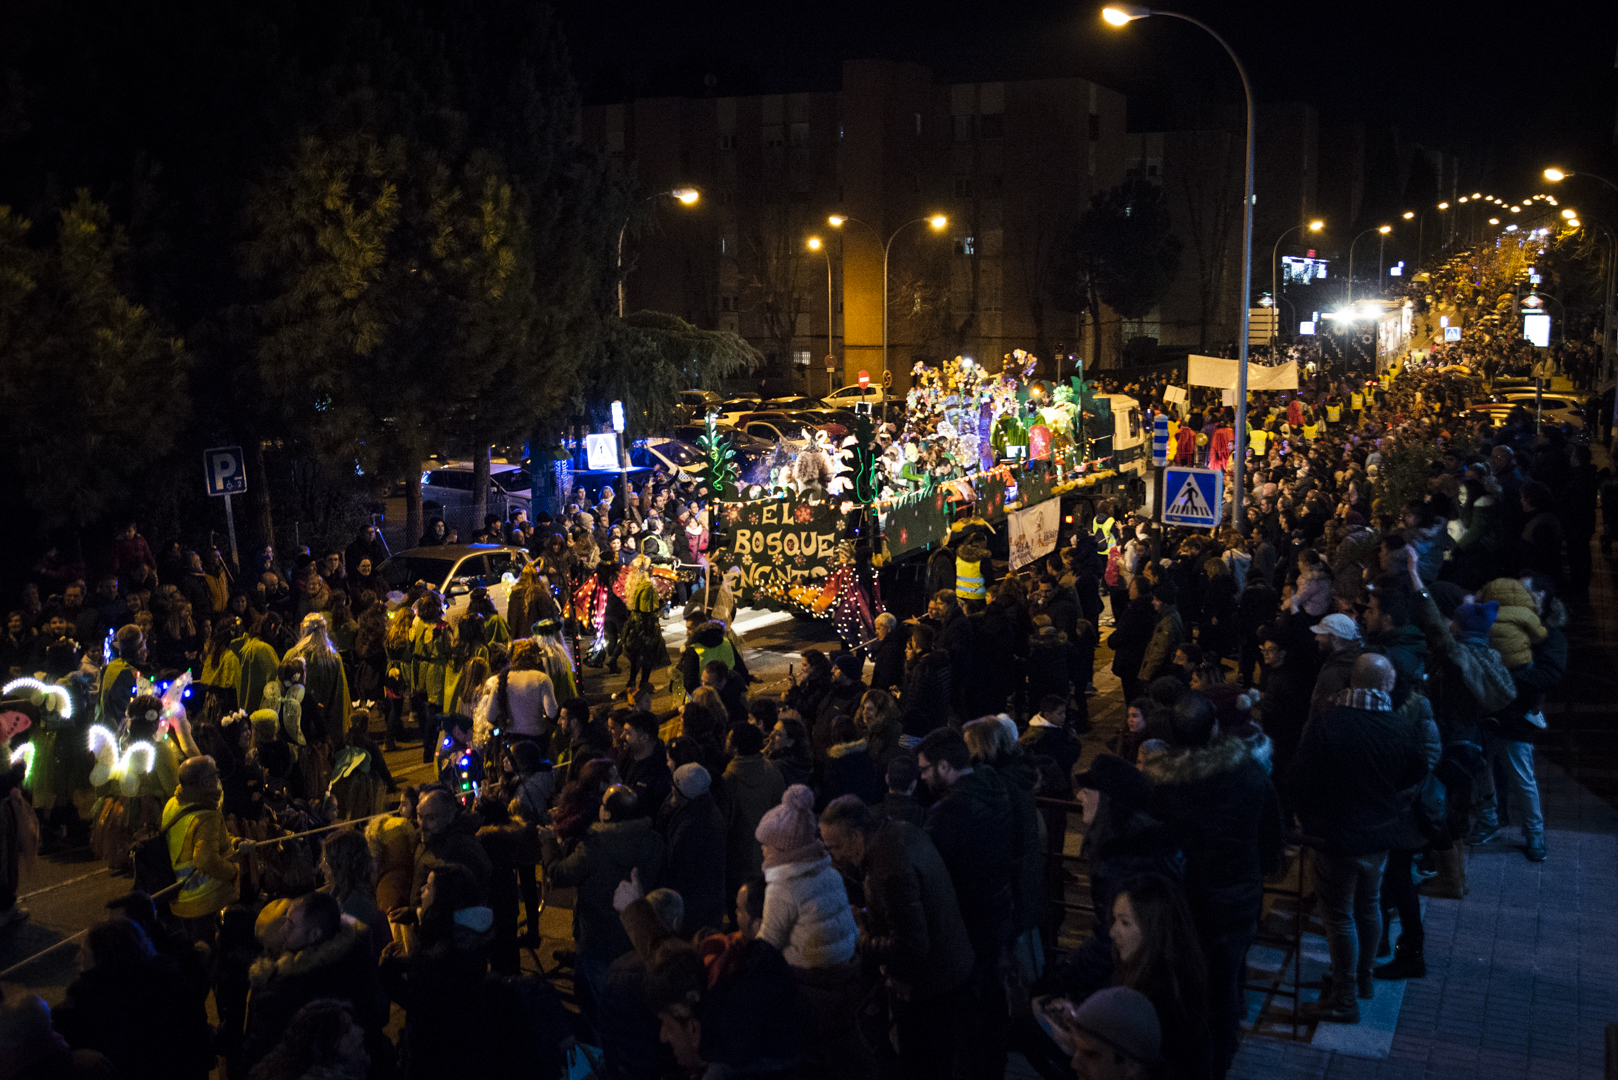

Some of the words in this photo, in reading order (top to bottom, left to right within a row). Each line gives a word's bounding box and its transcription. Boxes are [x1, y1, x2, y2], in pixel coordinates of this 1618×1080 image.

[212, 453, 236, 490] P
[761, 502, 795, 526] EL
[734, 529, 835, 559] BOSQUE
